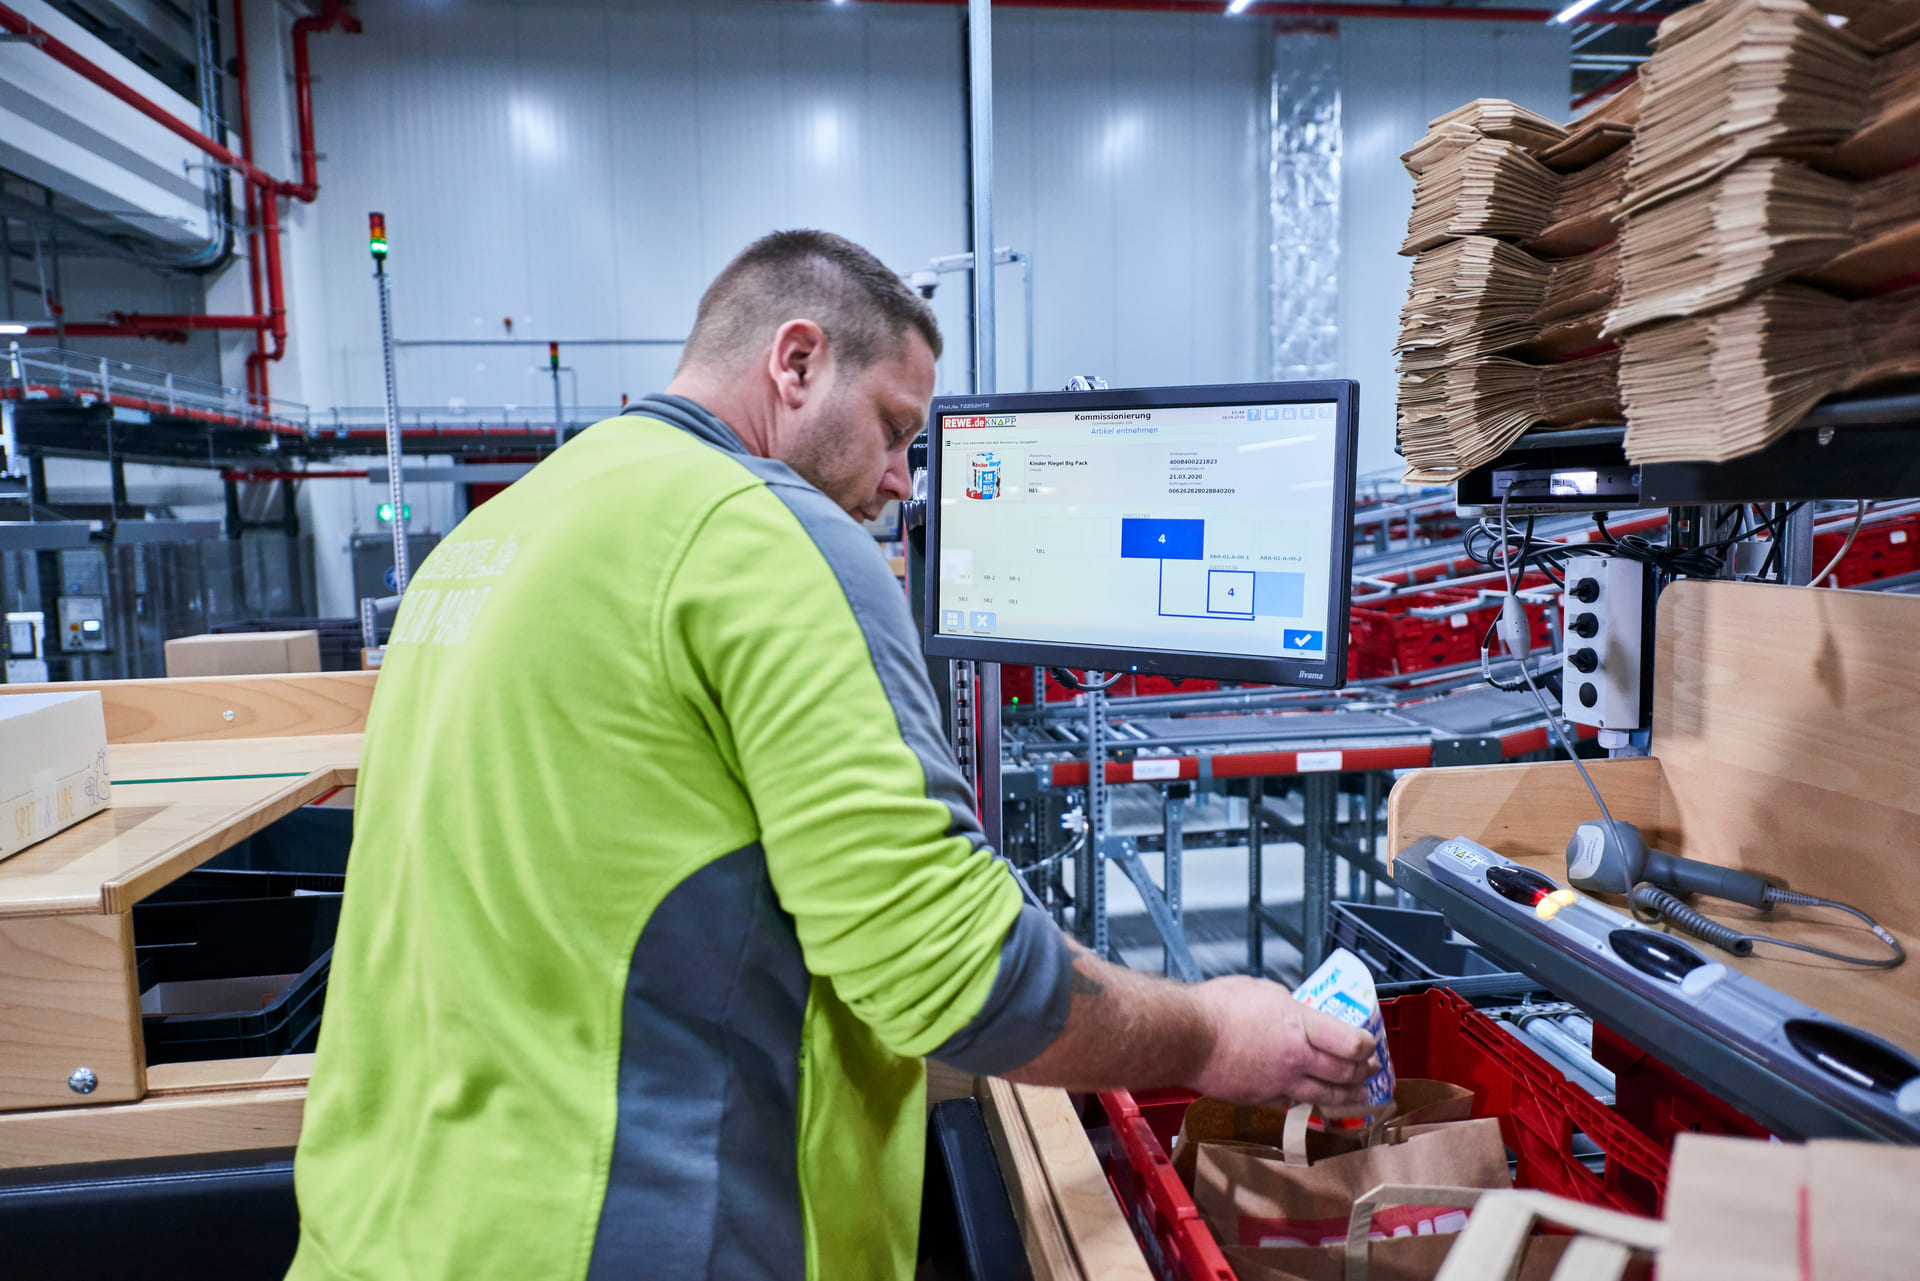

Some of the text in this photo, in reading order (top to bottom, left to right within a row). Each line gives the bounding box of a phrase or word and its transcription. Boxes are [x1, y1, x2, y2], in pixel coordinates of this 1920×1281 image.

[1074, 412, 1152, 421] Kommissionierung
[944, 418, 985, 429] REWE.de
[1091, 426, 1158, 435] Artikel entnehmen
[1048, 460, 1065, 468] Riegel
[1065, 460, 1074, 468] Big
[1158, 534, 1166, 544] 4
[1227, 587, 1235, 597] 4
